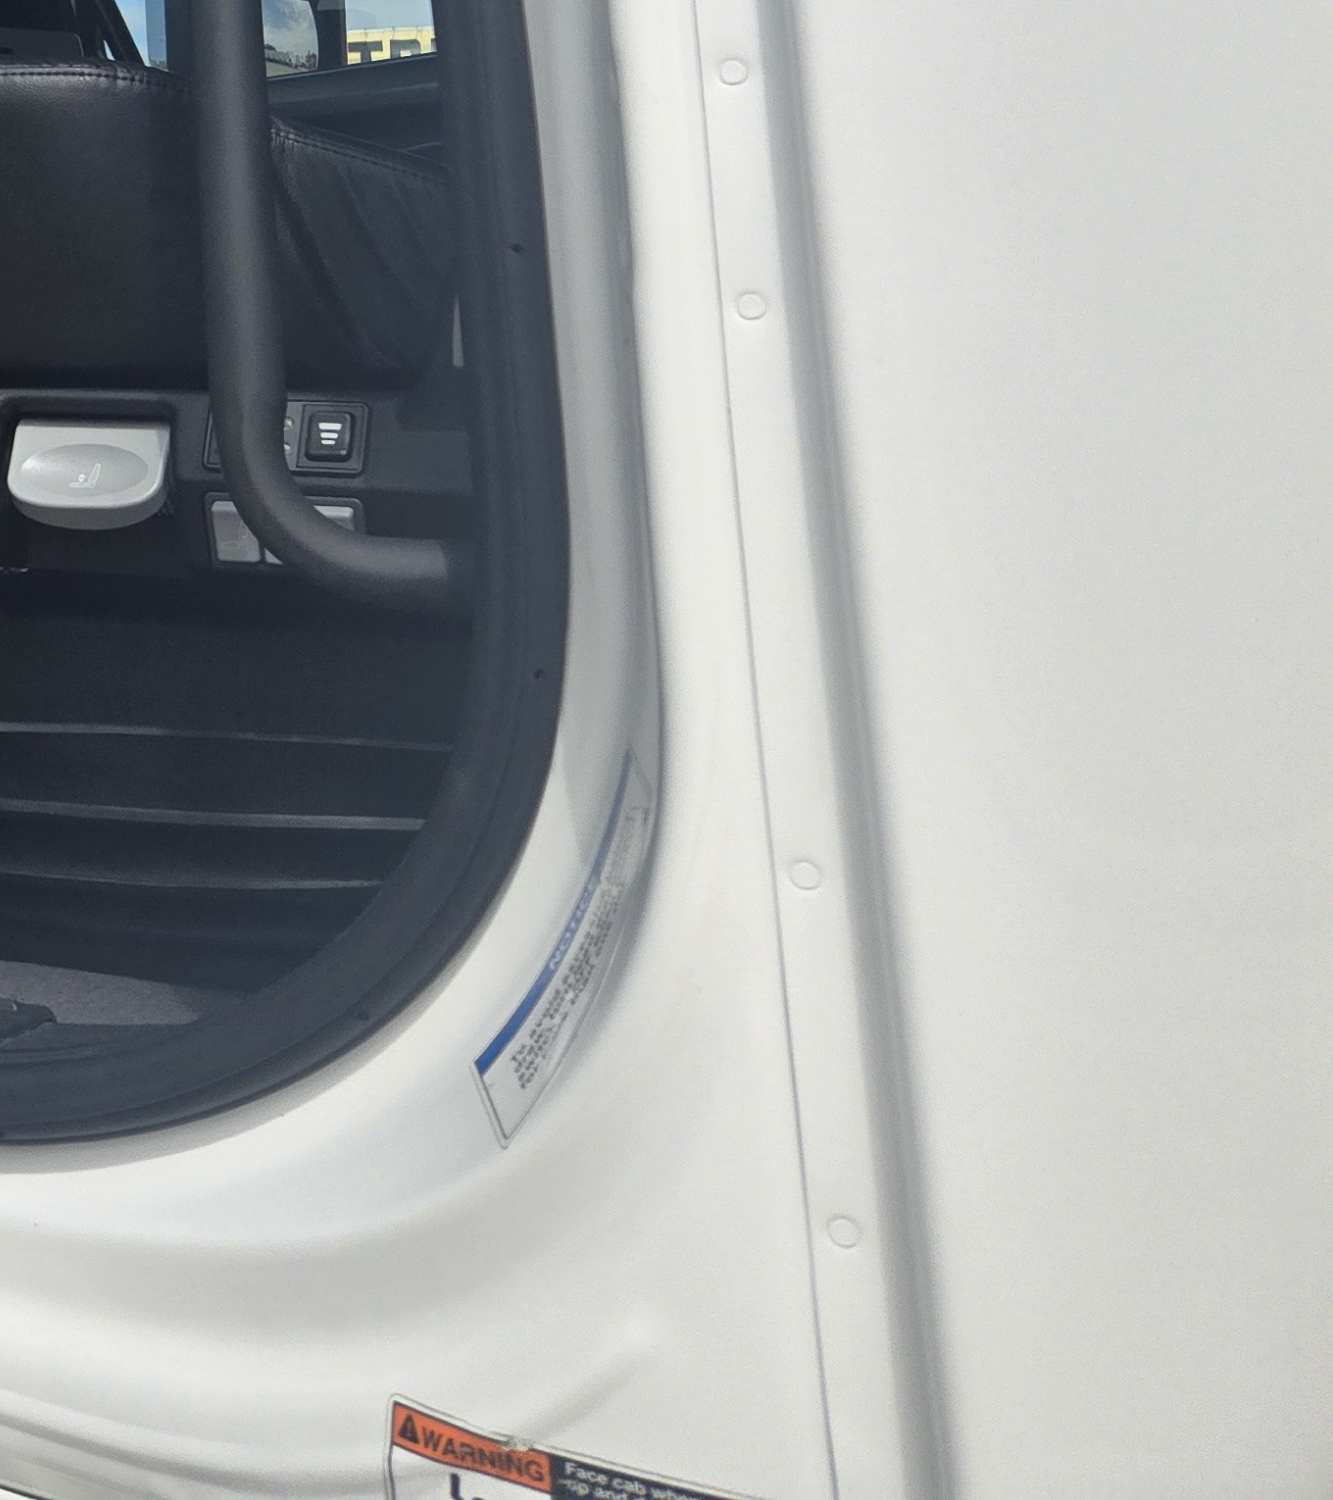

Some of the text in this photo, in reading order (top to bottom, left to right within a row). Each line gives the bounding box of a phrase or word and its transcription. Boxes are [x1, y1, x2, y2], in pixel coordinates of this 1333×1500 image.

[422, 1425, 545, 1483] WARNING
[564, 1461, 608, 1485] Face
[612, 1476, 647, 1496] cab
